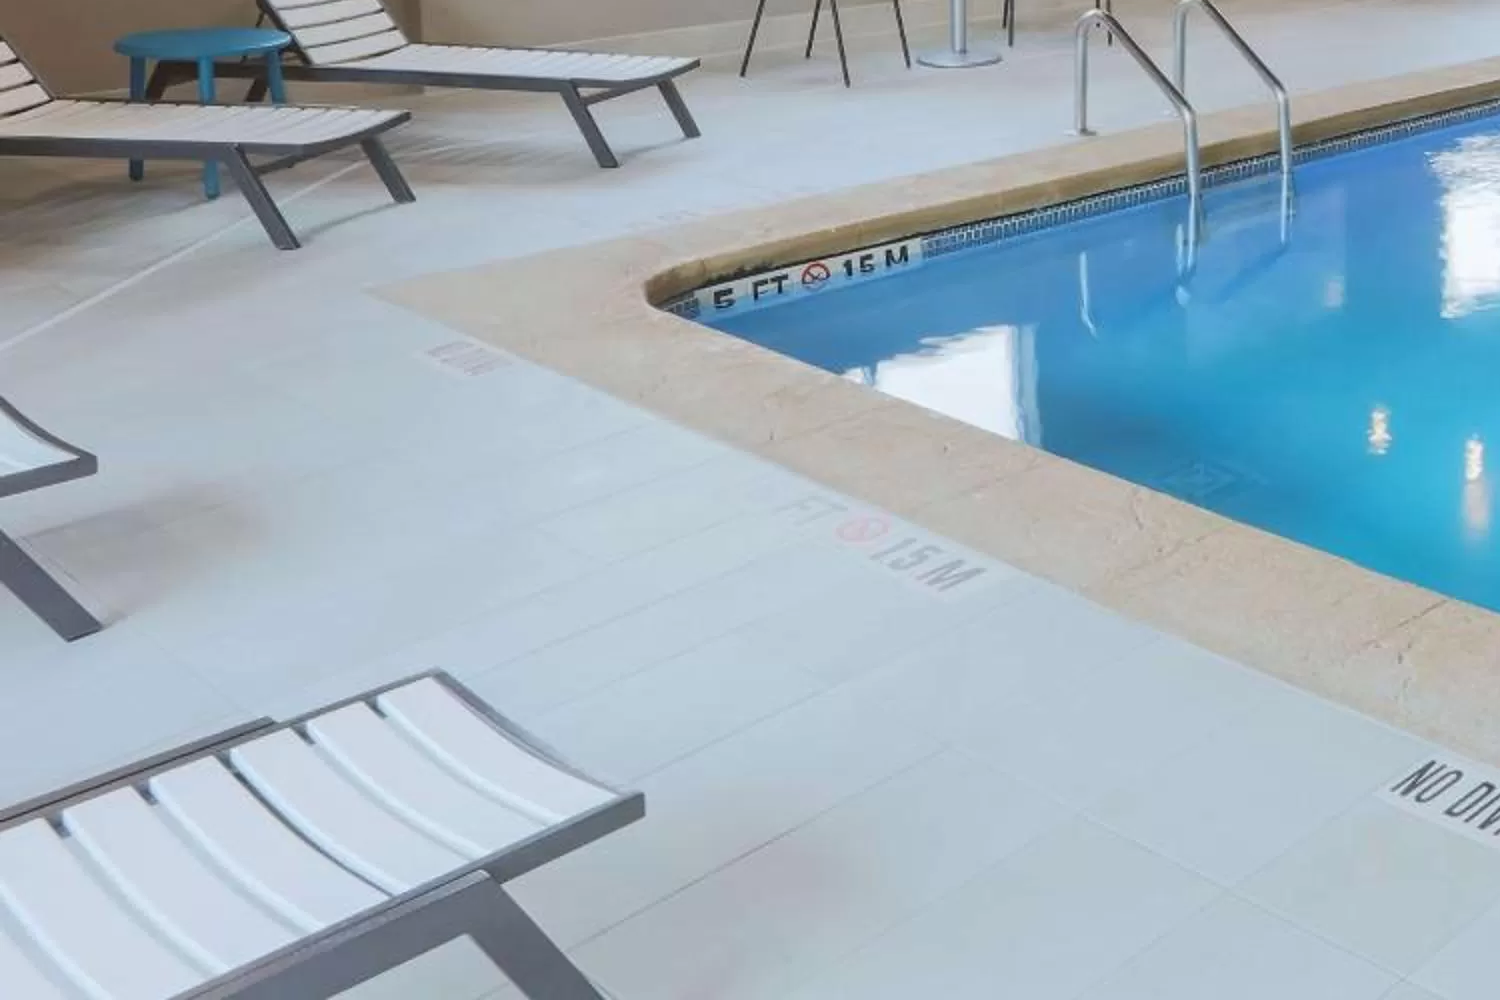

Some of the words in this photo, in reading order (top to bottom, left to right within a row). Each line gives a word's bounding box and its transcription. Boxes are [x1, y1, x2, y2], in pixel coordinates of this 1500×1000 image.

[713, 287, 735, 309] 5
[752, 274, 789, 300] FT
[1389, 759, 1464, 804] NO
